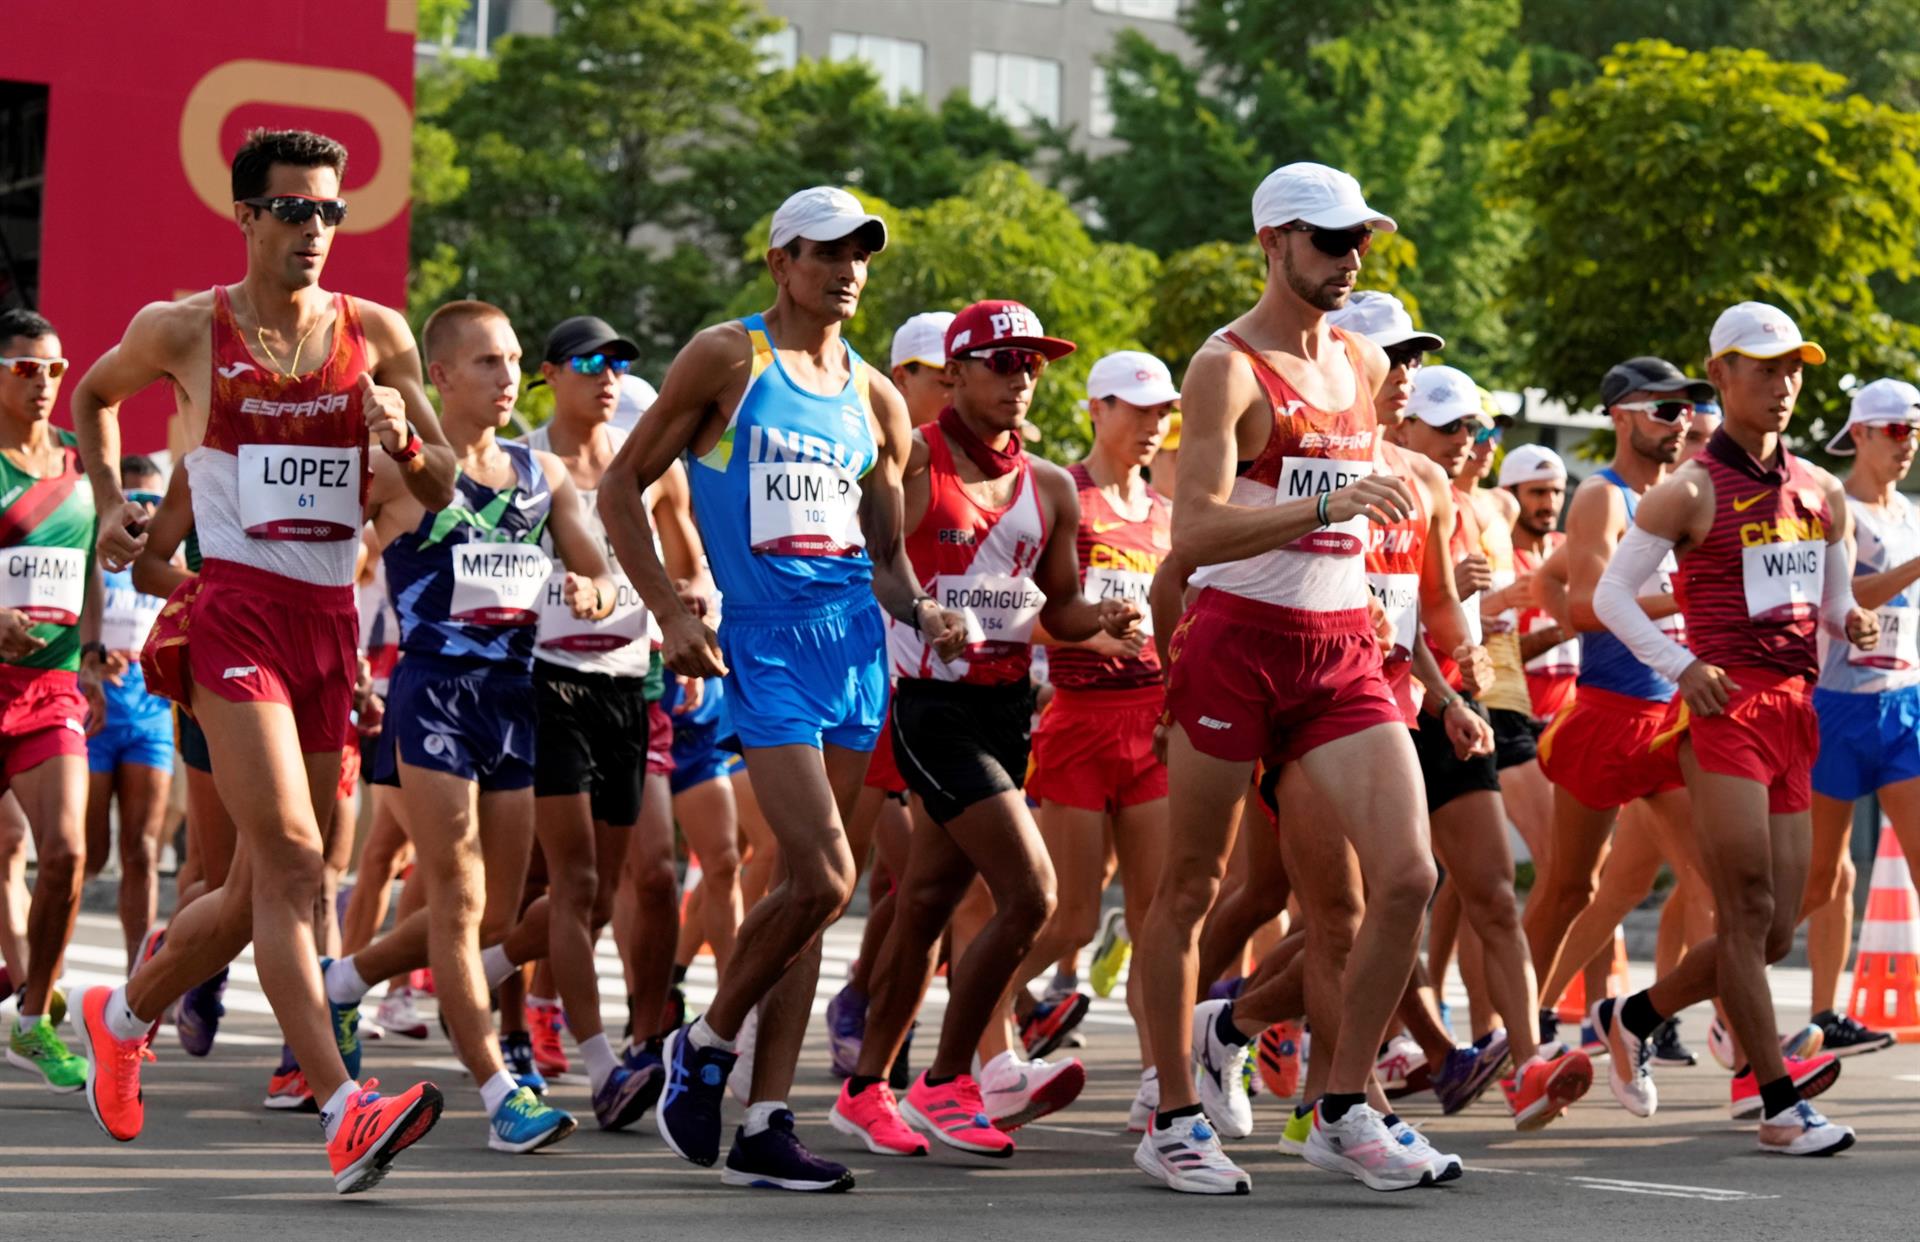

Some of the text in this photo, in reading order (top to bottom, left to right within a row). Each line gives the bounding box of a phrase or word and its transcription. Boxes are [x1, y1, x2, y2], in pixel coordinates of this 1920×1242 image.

[240, 394, 349, 417] ESPAÑA
[264, 457, 350, 487] LOPEZ
[766, 474, 850, 504] KUMAR
[298, 494, 315, 508] 61
[805, 509, 826, 523] 102
[9, 556, 77, 579] CHAMA
[463, 554, 544, 577] MIZINOV
[1763, 551, 1817, 577] WANG
[946, 589, 1039, 609] RODRIGUEZ
[981, 618, 1003, 630] 154
